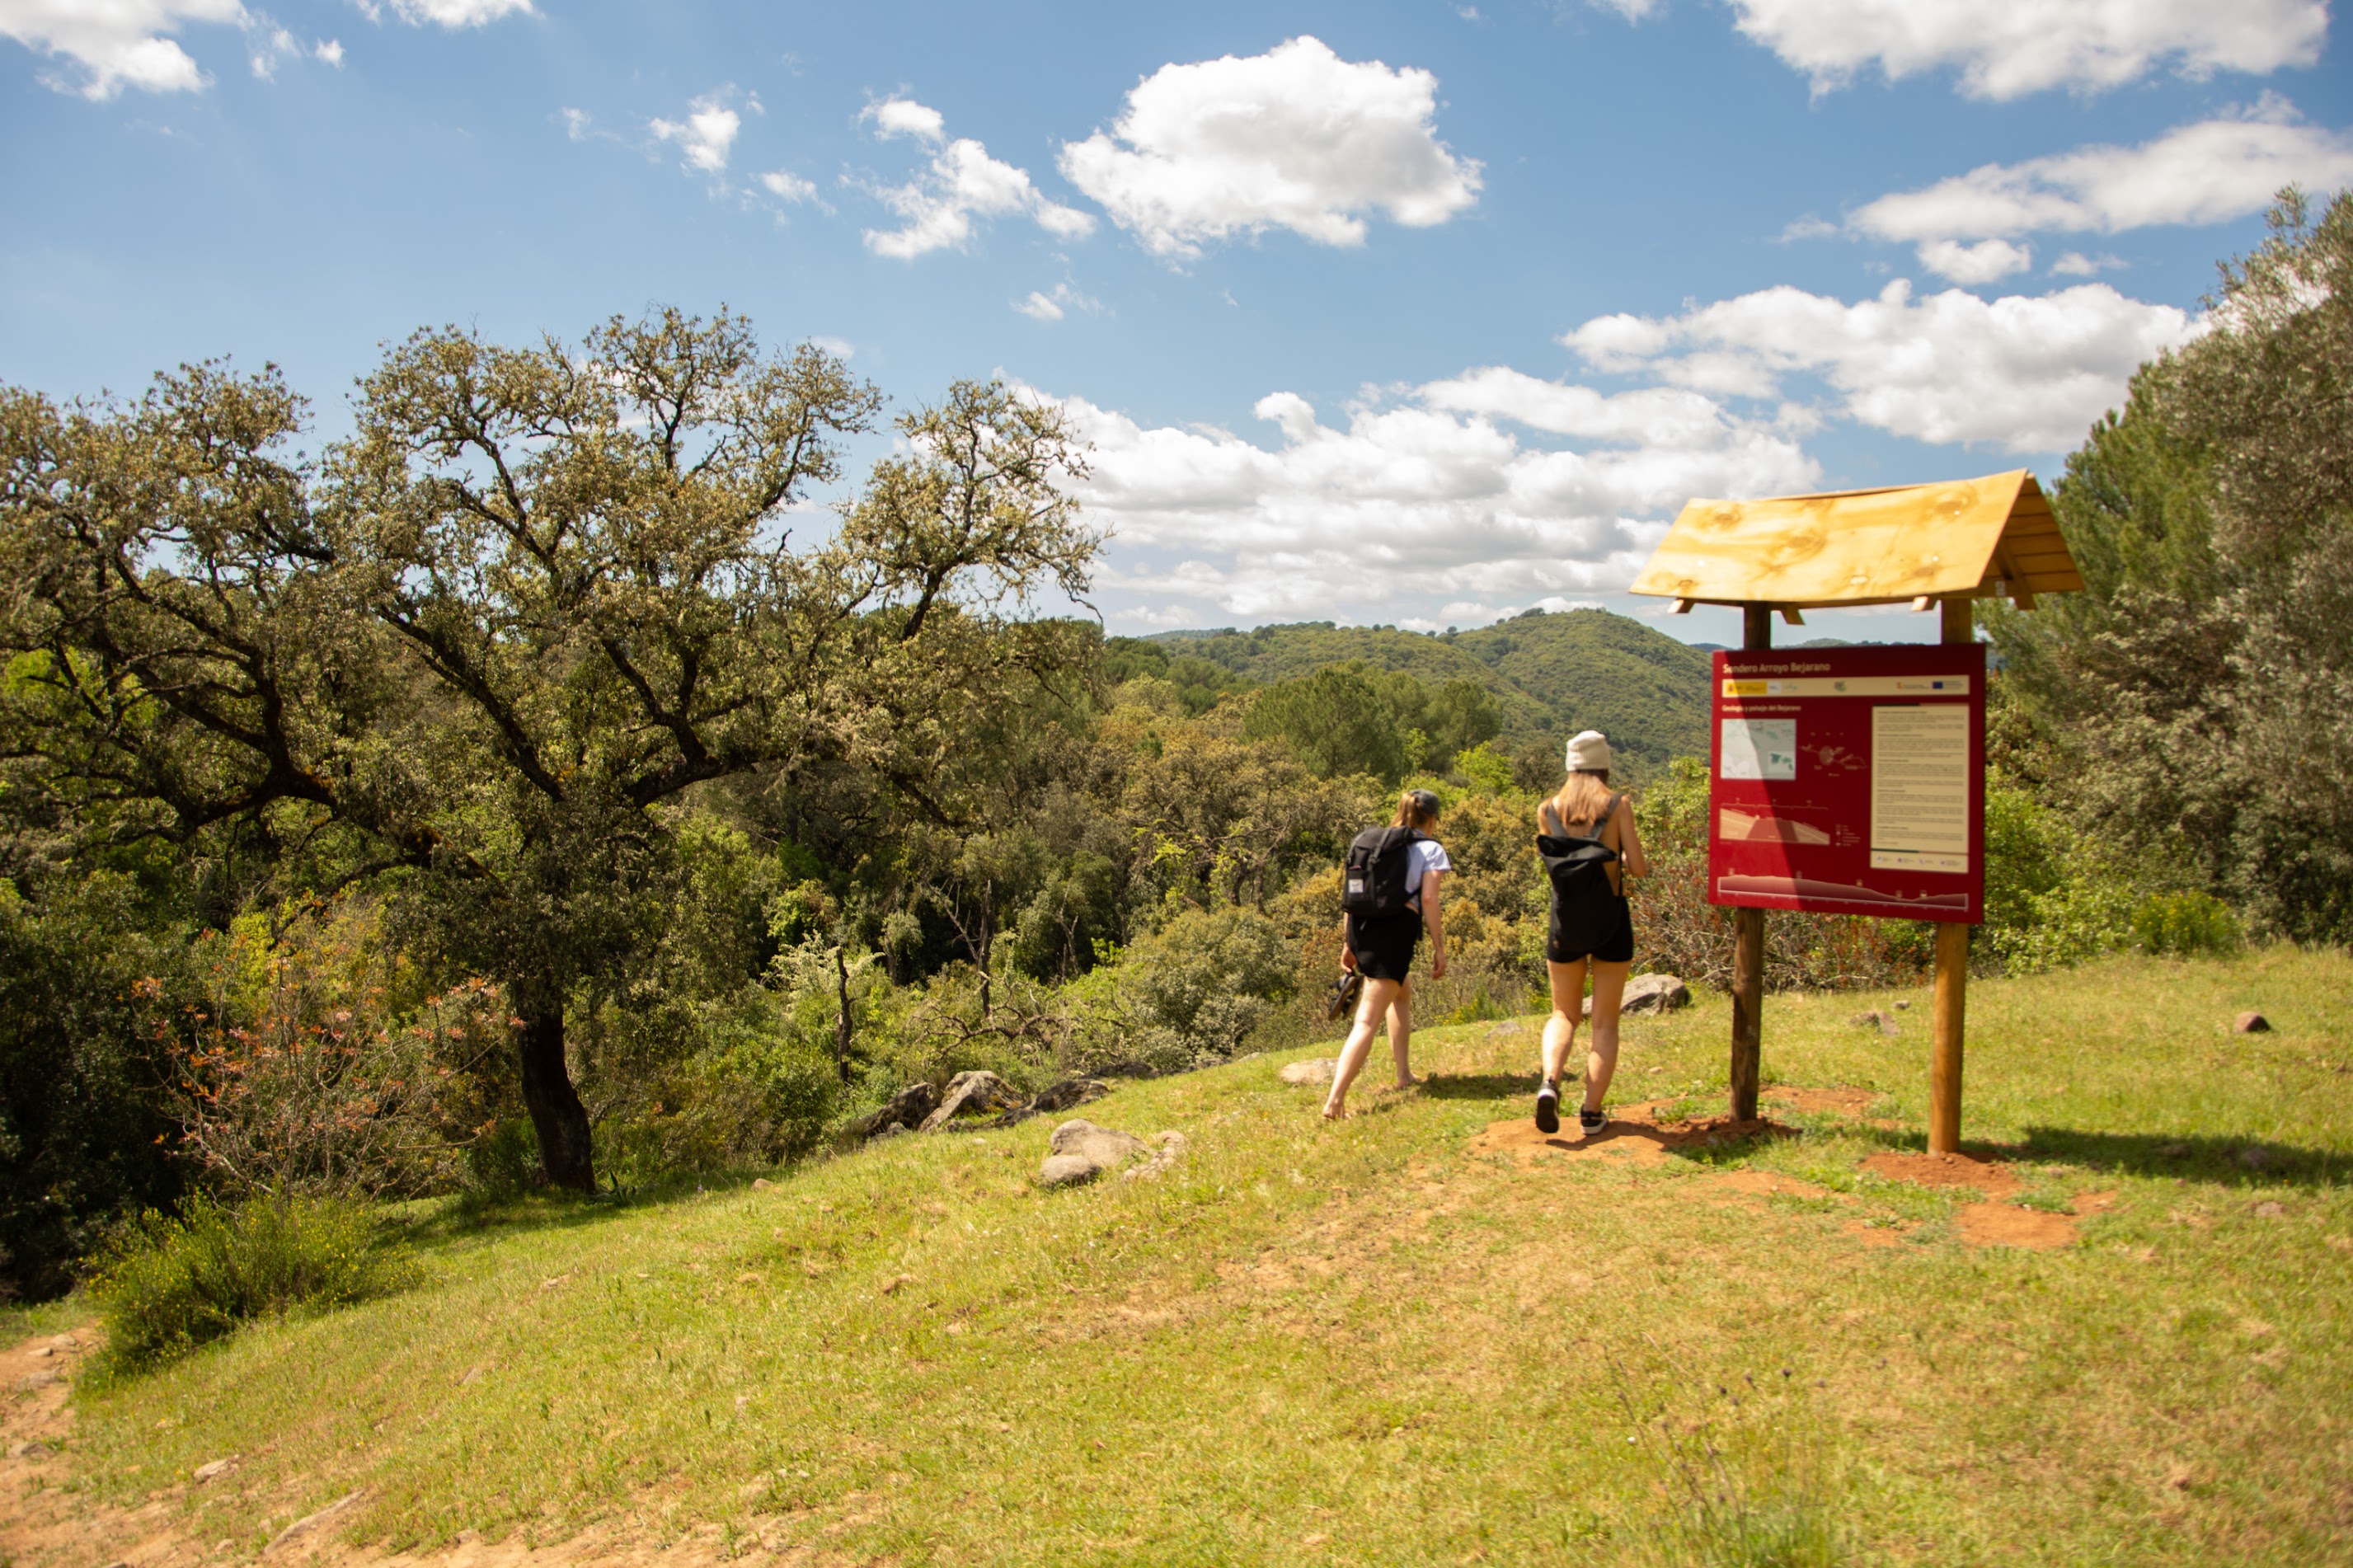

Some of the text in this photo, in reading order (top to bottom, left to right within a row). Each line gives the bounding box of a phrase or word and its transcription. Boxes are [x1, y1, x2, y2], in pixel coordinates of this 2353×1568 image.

[1722, 662, 1830, 674] Sendero Arroyo Bejarano
